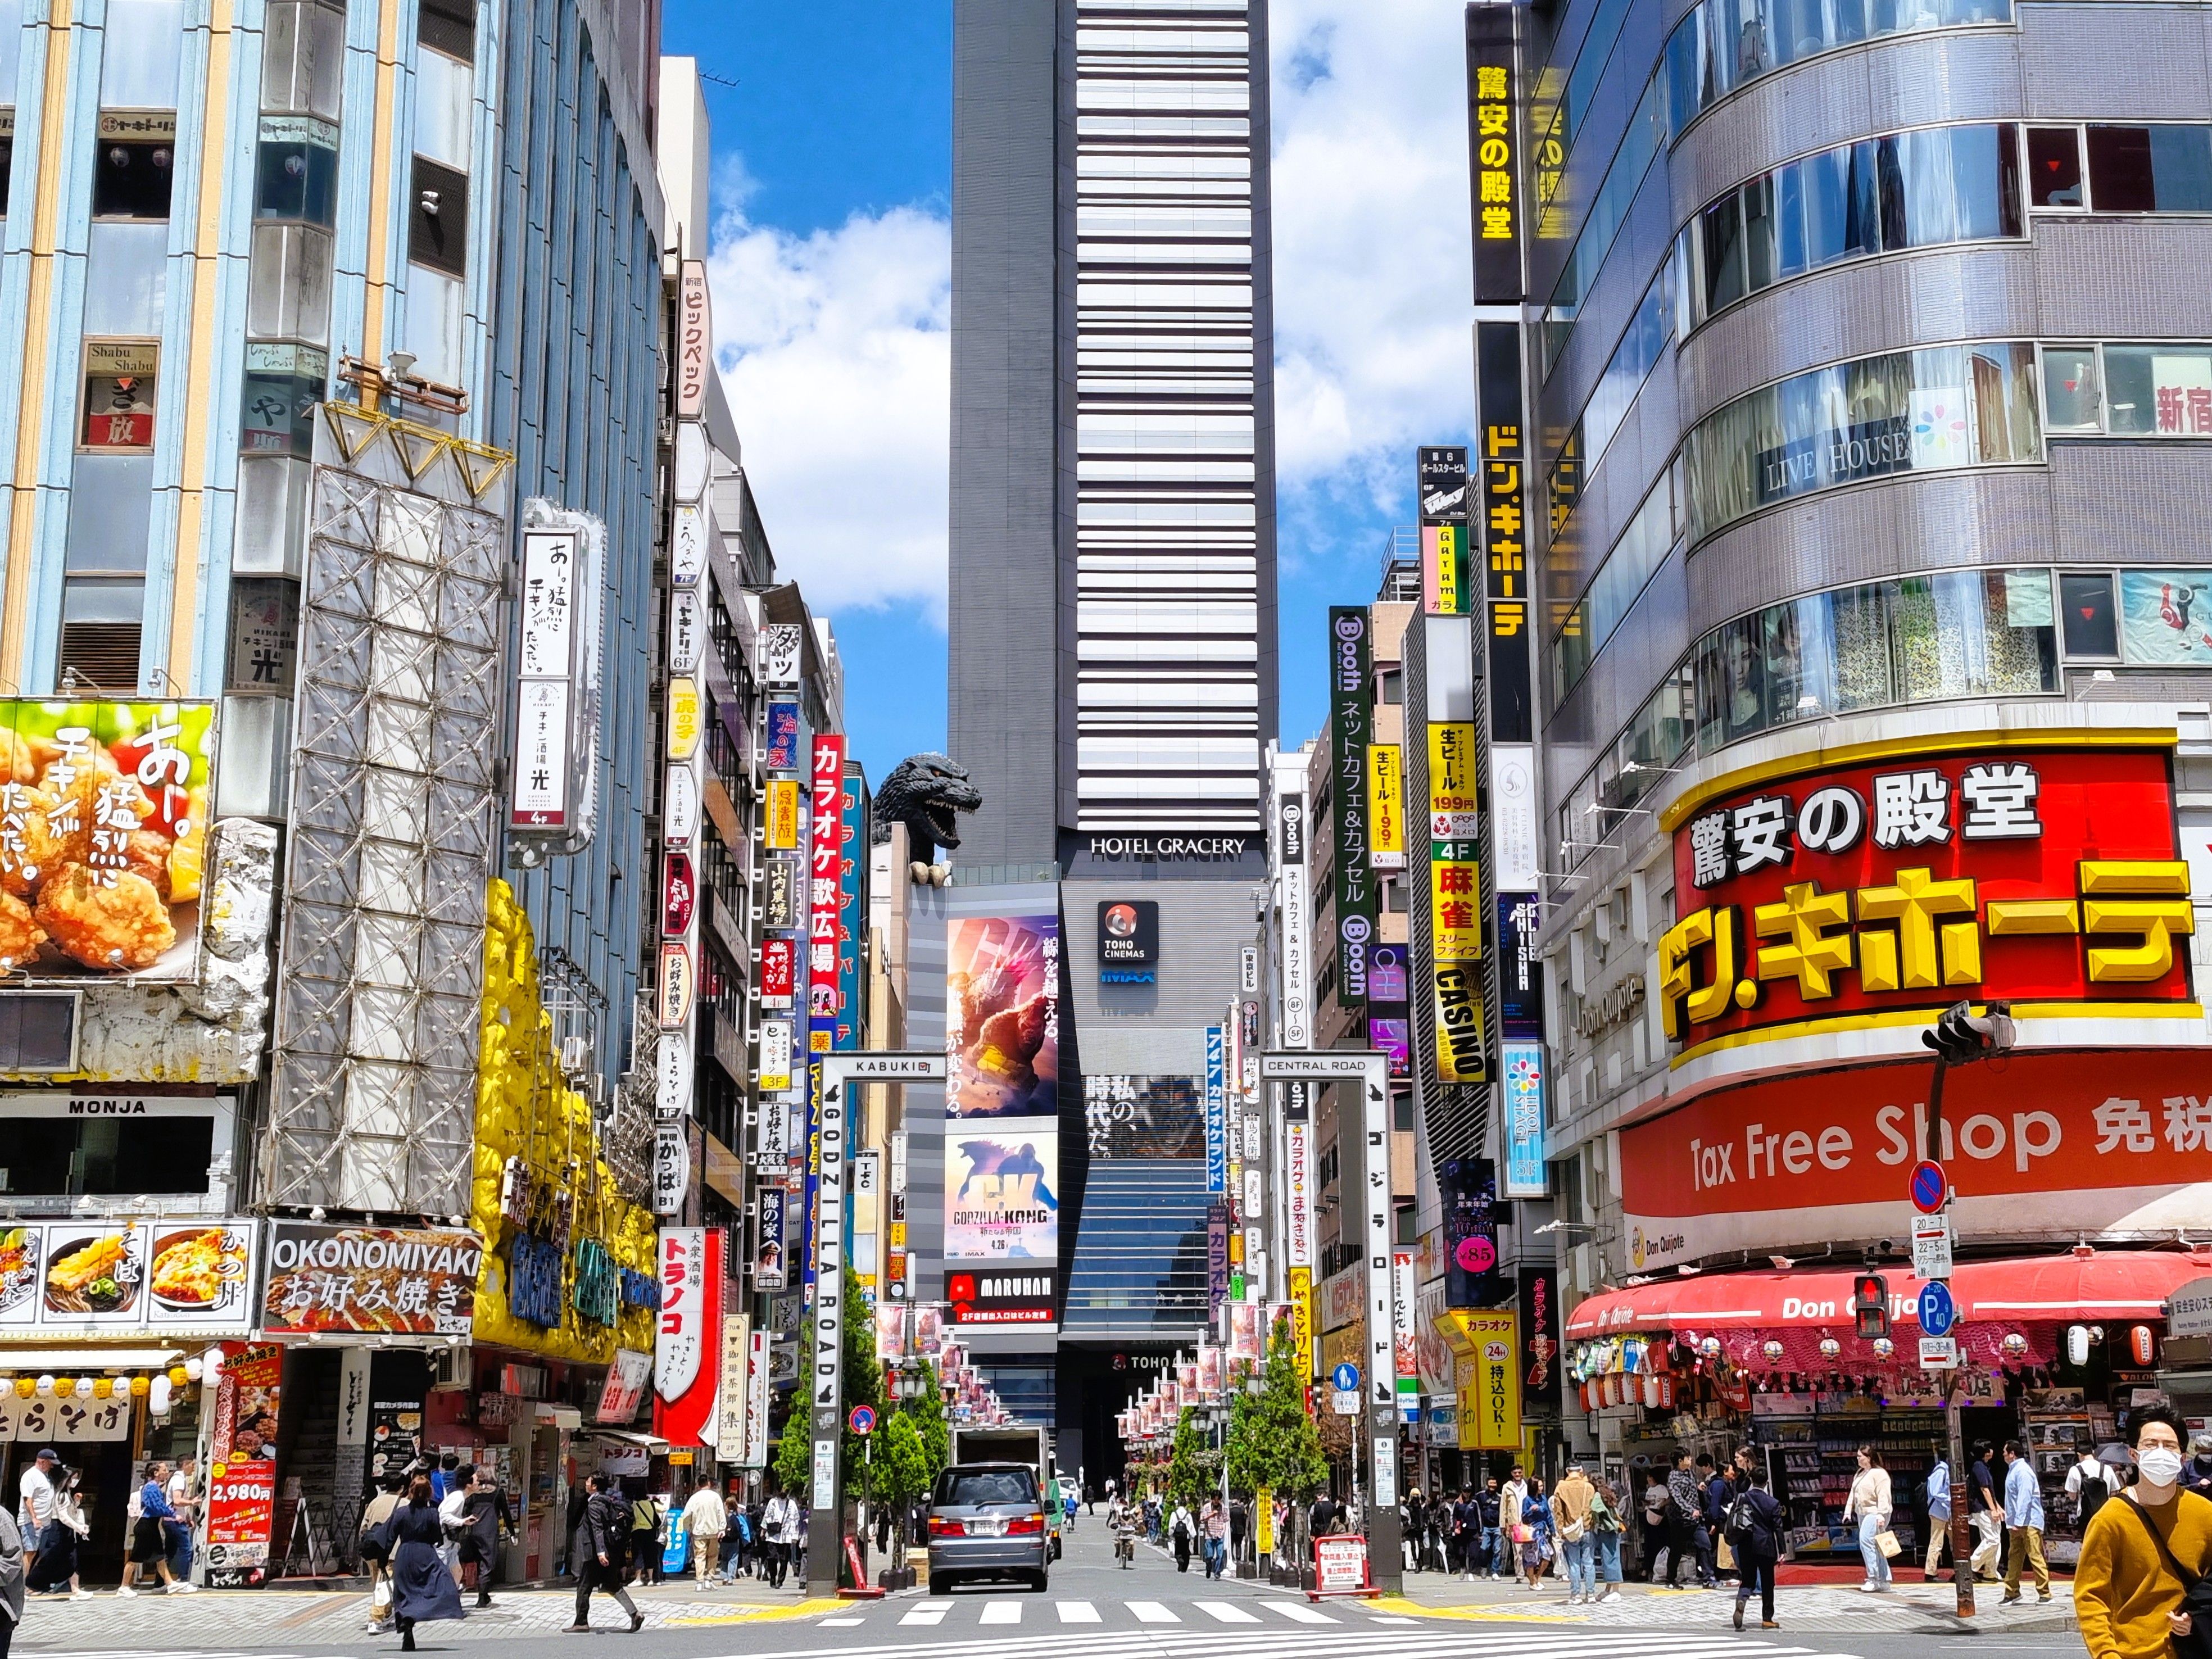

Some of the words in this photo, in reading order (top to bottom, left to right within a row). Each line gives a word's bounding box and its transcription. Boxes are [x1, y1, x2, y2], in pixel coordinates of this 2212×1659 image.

[1477, 66, 1512, 240] 驚安の殿堂
[685, 277, 702, 287] 新宿
[91, 346, 131, 358] Shabu
[114, 360, 153, 371] Shabu
[683, 291, 704, 399] ピックペック
[2157, 385, 2212, 433] 新宿
[1766, 450, 1817, 492] LIVE
[1829, 430, 1909, 474] HOUSE
[1431, 600, 1463, 610] ガラム
[251, 649, 283, 684] 光
[673, 657, 693, 668] 6F
[775, 630, 793, 677] ダーツ
[536, 711, 547, 765] チキン酒場
[674, 699, 696, 740] 虎の子
[768, 713, 797, 767] 海の家
[671, 746, 687, 754] 4F
[1440, 728, 1458, 791] 生ビール
[47, 727, 91, 839] チキンが
[133, 714, 192, 837] あー。
[531, 769, 550, 791] 光
[1376, 751, 1390, 801] 生ビール
[531, 811, 548, 824] 4F
[673, 814, 684, 827] 光
[1433, 796, 1475, 811] 199円
[0, 779, 38, 881] たべたい。
[89, 782, 143, 890] 猛烈に
[1091, 837, 1149, 854] HOTEL
[1157, 837, 1246, 854] GRACERY
[1381, 804, 1391, 847] 199円
[1690, 761, 2044, 890] 驚安の殿堂
[810, 744, 839, 973] カラオケ歌広場
[1441, 844, 1469, 859] 4F
[769, 864, 787, 917] 山内農場
[1288, 870, 1298, 928] ネットカフェ
[1439, 866, 1474, 931] 麻雀
[1104, 940, 1134, 950] TOHO
[1104, 949, 1145, 958] CINEMAS
[1437, 935, 1468, 944] スリー
[1437, 945, 1479, 956] ファイブ
[668, 957, 682, 1017] お好み焼き
[1100, 971, 1155, 983] IMAX
[1245, 954, 1254, 988] 東京ビル
[1289, 949, 1300, 990] カプセル
[769, 997, 784, 1008] 4F
[1435, 968, 1485, 1075] CASINO
[1581, 1007, 1600, 1037] Don
[811, 1034, 831, 1050] 薬
[1208, 1035, 1222, 1078] 747
[667, 1051, 679, 1104] とらそば
[767, 1077, 783, 1087] 3F
[1268, 1061, 1327, 1071] CENTRAL
[1331, 1061, 1366, 1071] ROAD
[69, 1100, 147, 1114] MONJA
[661, 1108, 677, 1117] 1F
[1085, 1075, 1112, 1159] 時代だ。
[1110, 1075, 1137, 1131] 私の、
[1513, 1095, 1528, 1145] STAGE
[1526, 1096, 1540, 1137] IDOL
[659, 1133, 678, 1141] 新宿
[764, 1104, 782, 1152] お好み焼
[1209, 1085, 1223, 1186] カラオケランド
[1690, 1136, 1737, 1193] Tax
[1747, 1122, 1854, 1181] Free
[1875, 1101, 2064, 1173] Shop
[2091, 1095, 2212, 1154] 免税
[657, 1141, 678, 1191] かっぱ
[759, 1153, 786, 1166] 大阪家
[1291, 1135, 1306, 1184] カラオケ
[1516, 1159, 1539, 1176] 5F
[658, 1196, 674, 1207] B1
[820, 1108, 841, 1275] GODZILLA
[763, 1193, 779, 1238] 海の家
[1293, 1194, 1307, 1263] まねきねこ
[19, 1230, 37, 1294] とんかつ
[114, 1231, 140, 1283] そば
[273, 1239, 482, 1277] OKONOMIYAKI
[687, 1231, 702, 1289] 大衆酒場
[1368, 1131, 1388, 1355] ゴジラロード
[1458, 1246, 1492, 1262] ¥85
[1646, 1239, 1658, 1256] Don
[1660, 1233, 1684, 1254] Quijote
[212, 1230, 244, 1309] かつ丼
[661, 1238, 687, 1335] トラノコ
[981, 1277, 1051, 1297] MARUHAN
[1209, 1231, 1226, 1302] カラオケ
[280, 1273, 460, 1316] お好み焼き
[1394, 1299, 1406, 1329] 九十九
[1533, 1277, 1546, 1333] カラオケ
[1782, 1298, 1836, 1319] Don
[1924, 1294, 1938, 1328] P
[818, 1295, 837, 1376] ROAD
[1466, 1320, 1513, 1332] カラオケ
[1935, 1312, 1946, 1328] 40
[661, 1343, 681, 1386] やきとん
[677, 1335, 696, 1377] やきとり
[1131, 1357, 1168, 1368] TOHO
[1487, 1346, 1507, 1357] 24H
[722, 1411, 740, 1429] 集
[604, 1448, 643, 1459] トラノコ
[212, 1483, 270, 1503] 2,980円
